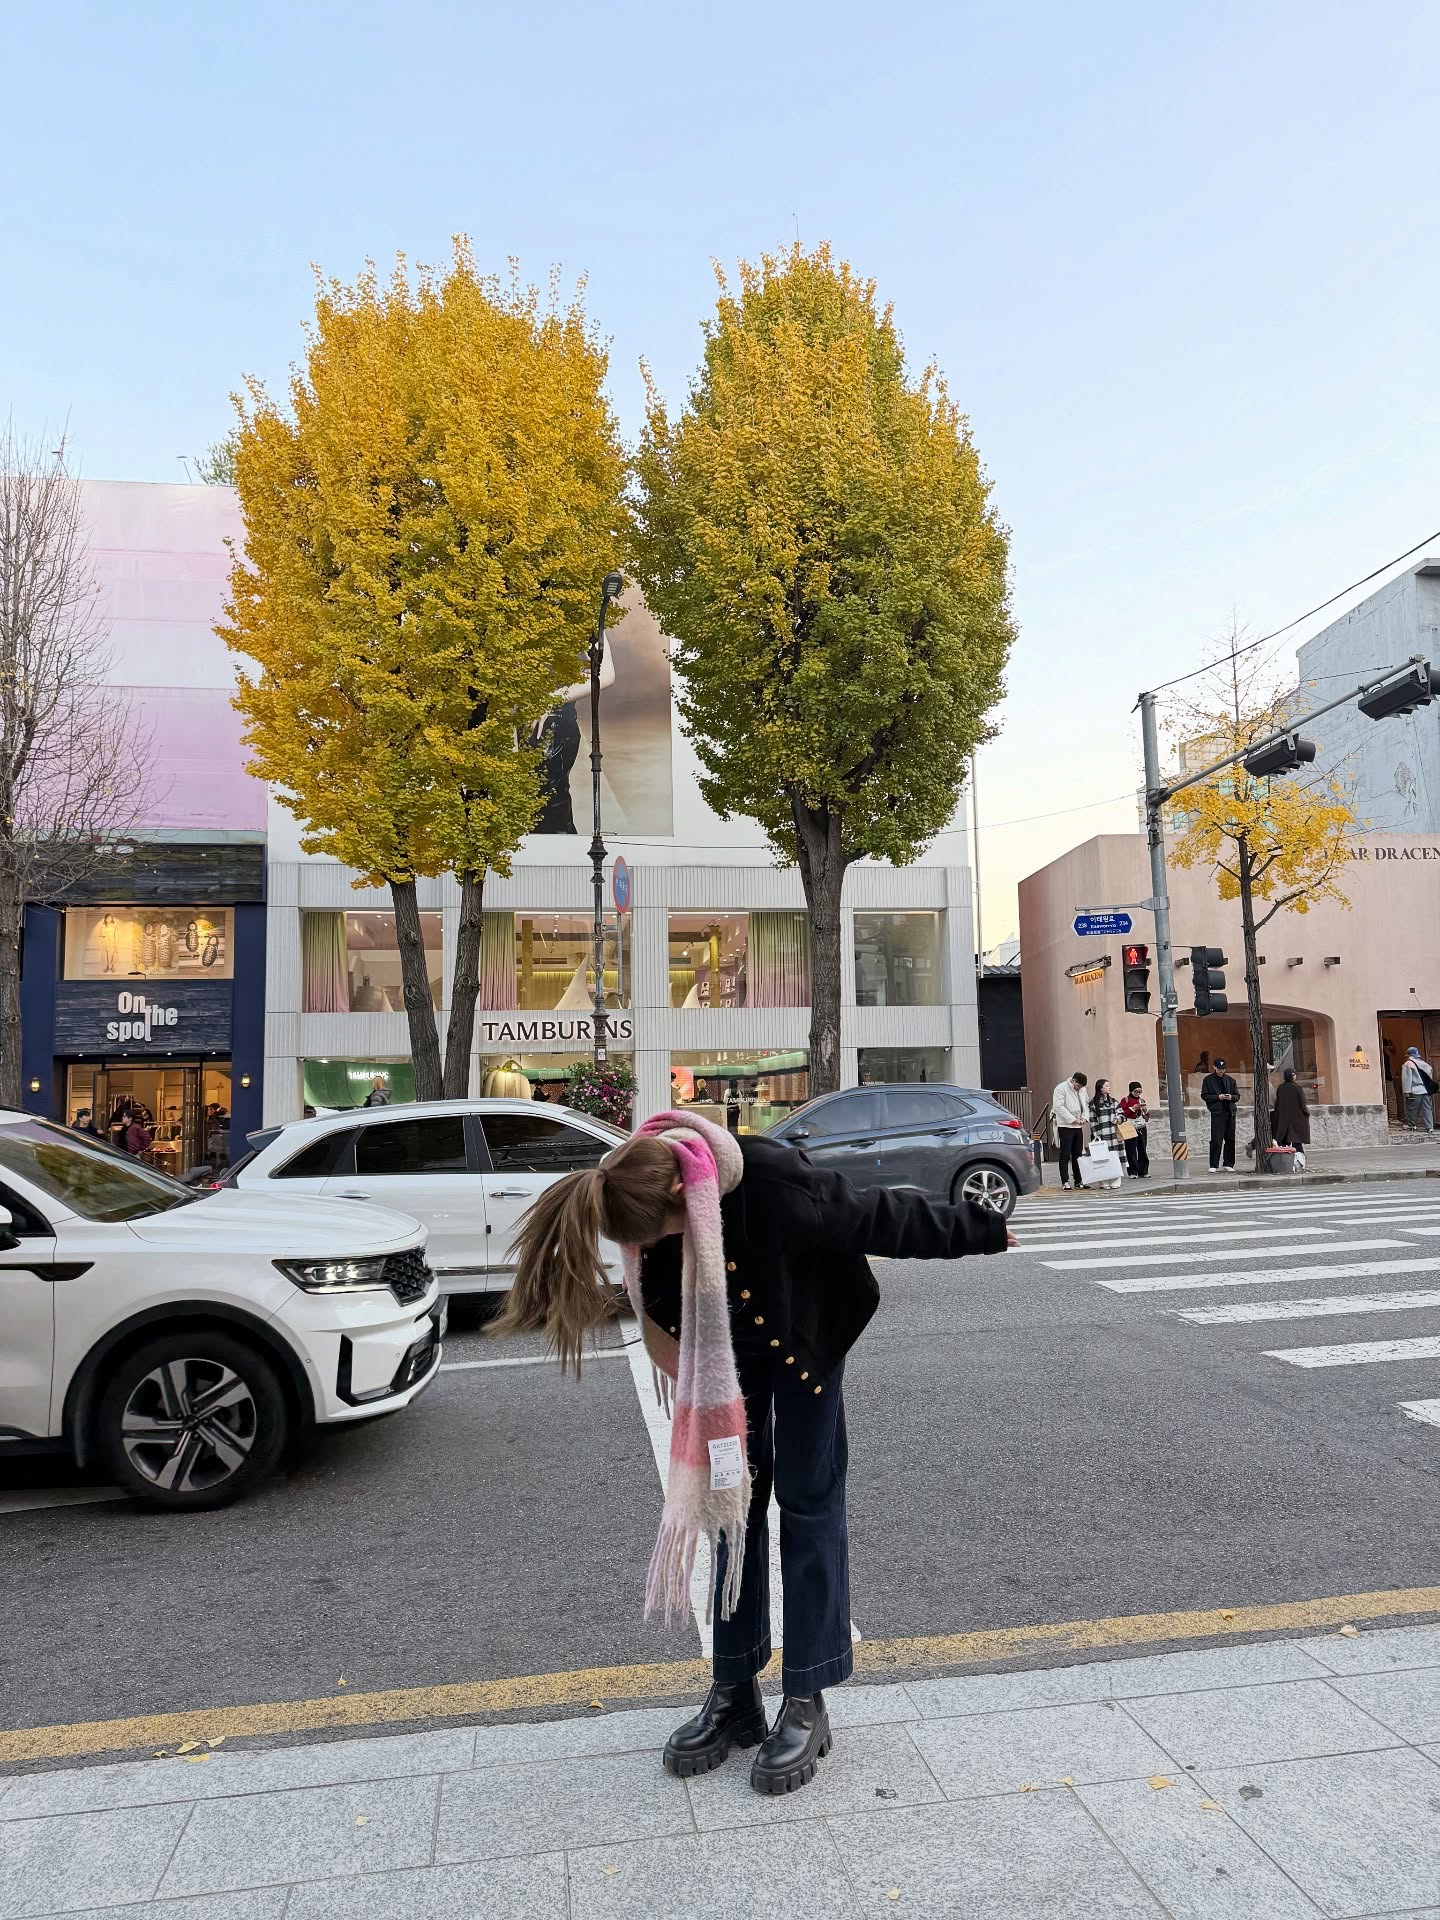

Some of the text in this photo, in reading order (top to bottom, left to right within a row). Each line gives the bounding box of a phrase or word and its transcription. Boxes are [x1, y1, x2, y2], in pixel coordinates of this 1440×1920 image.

[1090, 915, 1115, 923] 이태원로
[118, 991, 146, 1014] On
[145, 1004, 178, 1026] the
[106, 1021, 152, 1042] spot
[482, 1020, 633, 1041] TAMBURNS
